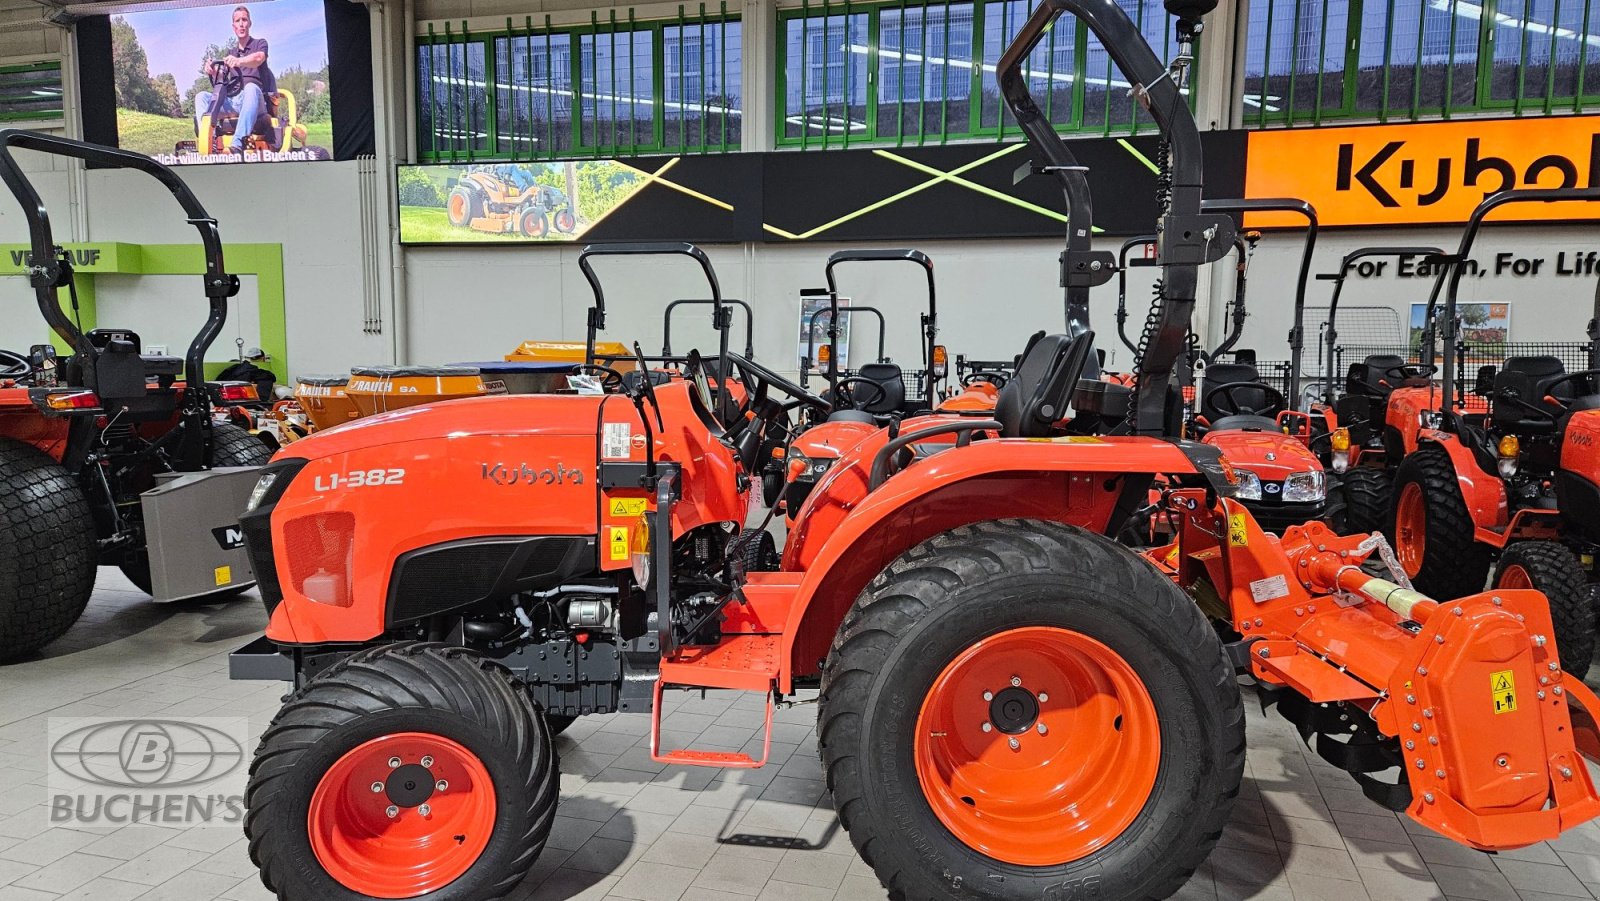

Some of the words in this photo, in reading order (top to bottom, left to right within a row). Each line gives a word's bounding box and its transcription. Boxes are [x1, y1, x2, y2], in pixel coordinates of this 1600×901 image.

[179, 152, 242, 165] willkommen
[244, 149, 260, 162] bei
[10, 249, 100, 266] VEAUF
[1495, 252, 1545, 275] For
[358, 381, 393, 392] RAUCH
[314, 468, 405, 492] L1-382
[481, 462, 584, 486] Kubota
